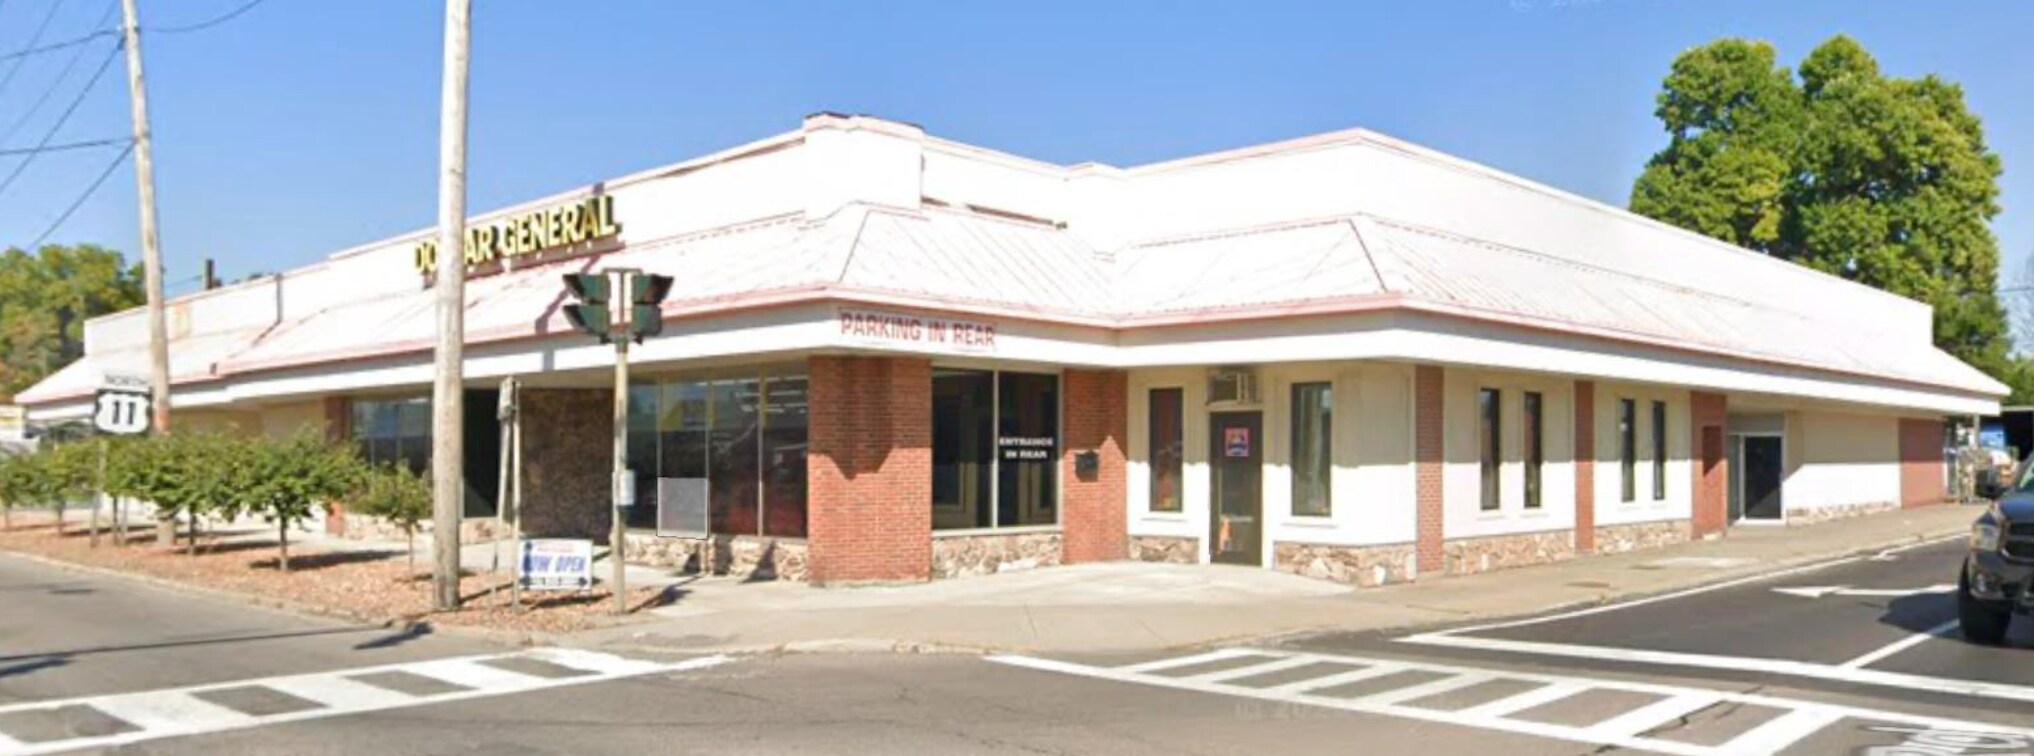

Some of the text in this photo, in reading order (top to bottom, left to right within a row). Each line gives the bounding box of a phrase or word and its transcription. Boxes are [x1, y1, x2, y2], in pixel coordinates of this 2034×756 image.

[413, 196, 618, 273] DOAR GENERAL
[840, 312, 996, 347] PARKING IN REAR
[105, 374, 148, 387] NORTH
[111, 401, 136, 425] 11
[999, 436, 1053, 447] ENTRANCE
[1005, 448, 1048, 459] IN REAR
[555, 554, 586, 573] OPEN
